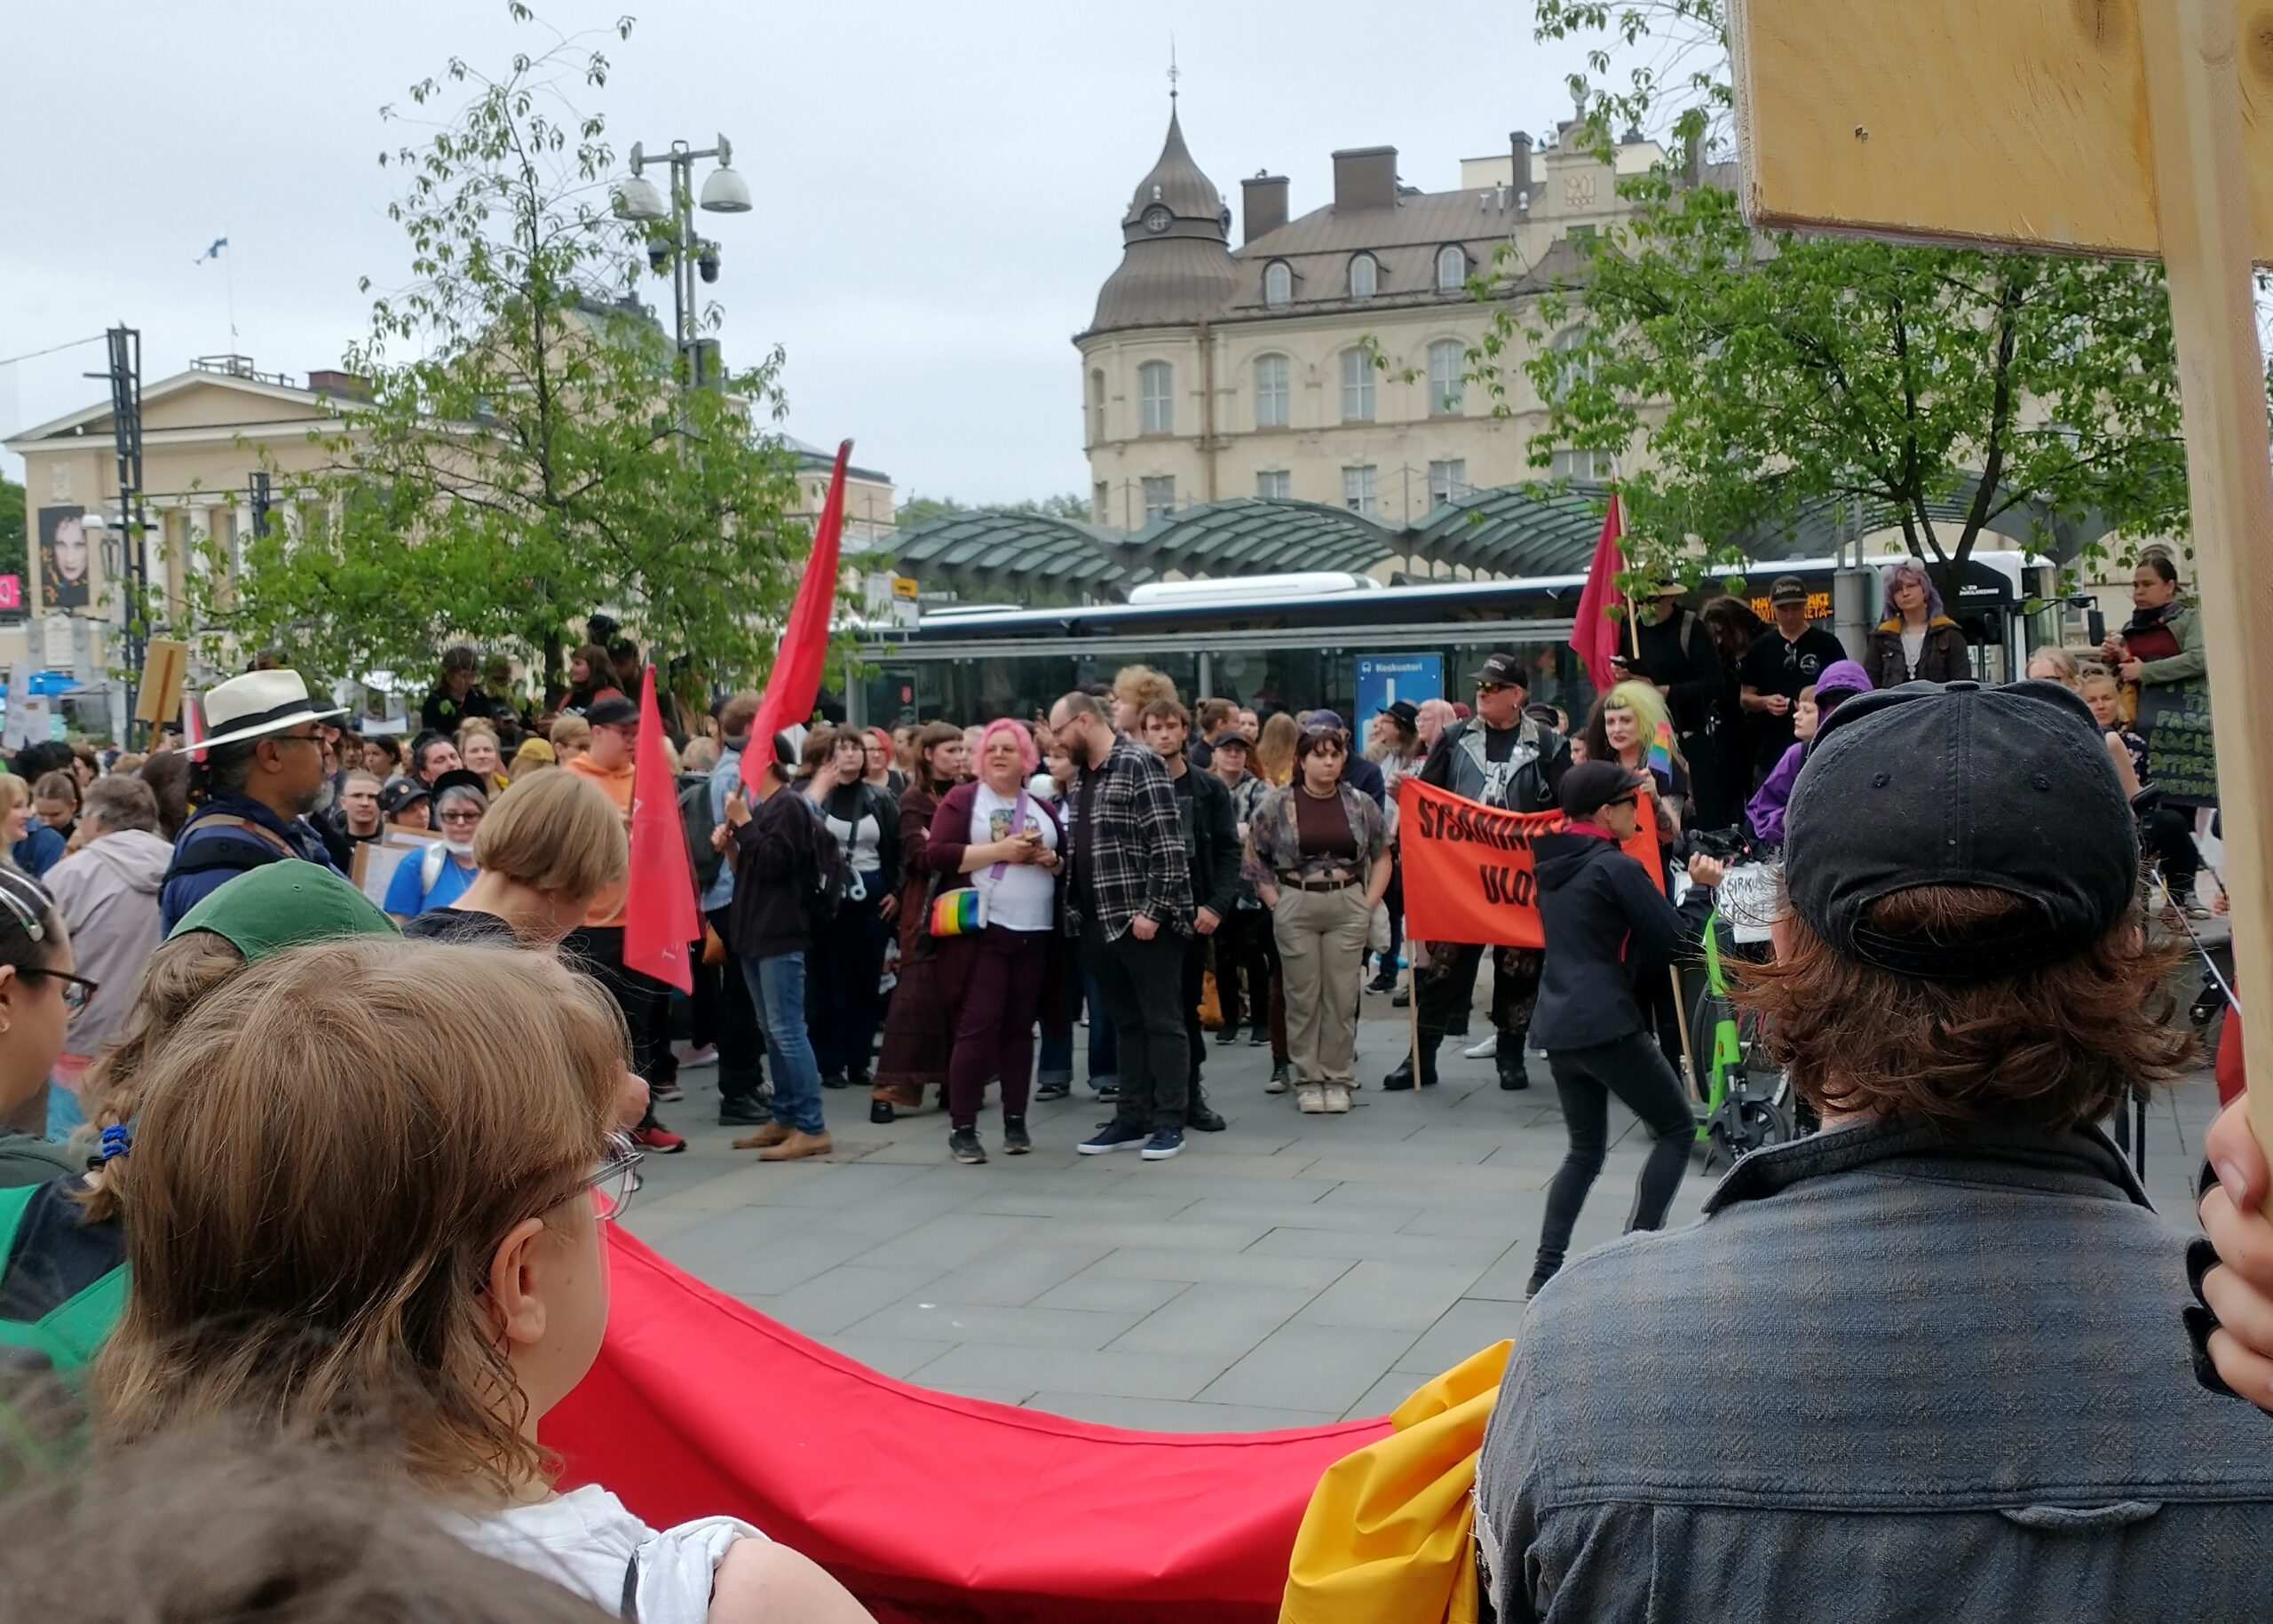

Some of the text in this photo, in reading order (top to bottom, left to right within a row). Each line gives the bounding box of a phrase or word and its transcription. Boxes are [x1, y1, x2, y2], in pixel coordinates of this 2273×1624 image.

[1564, 176, 1596, 199] 1901
[1375, 661, 1422, 673] Keskustori
[2156, 710, 2212, 733] FASC
[2150, 729, 2214, 755] RACIS
[1480, 864, 1539, 907] ULO
